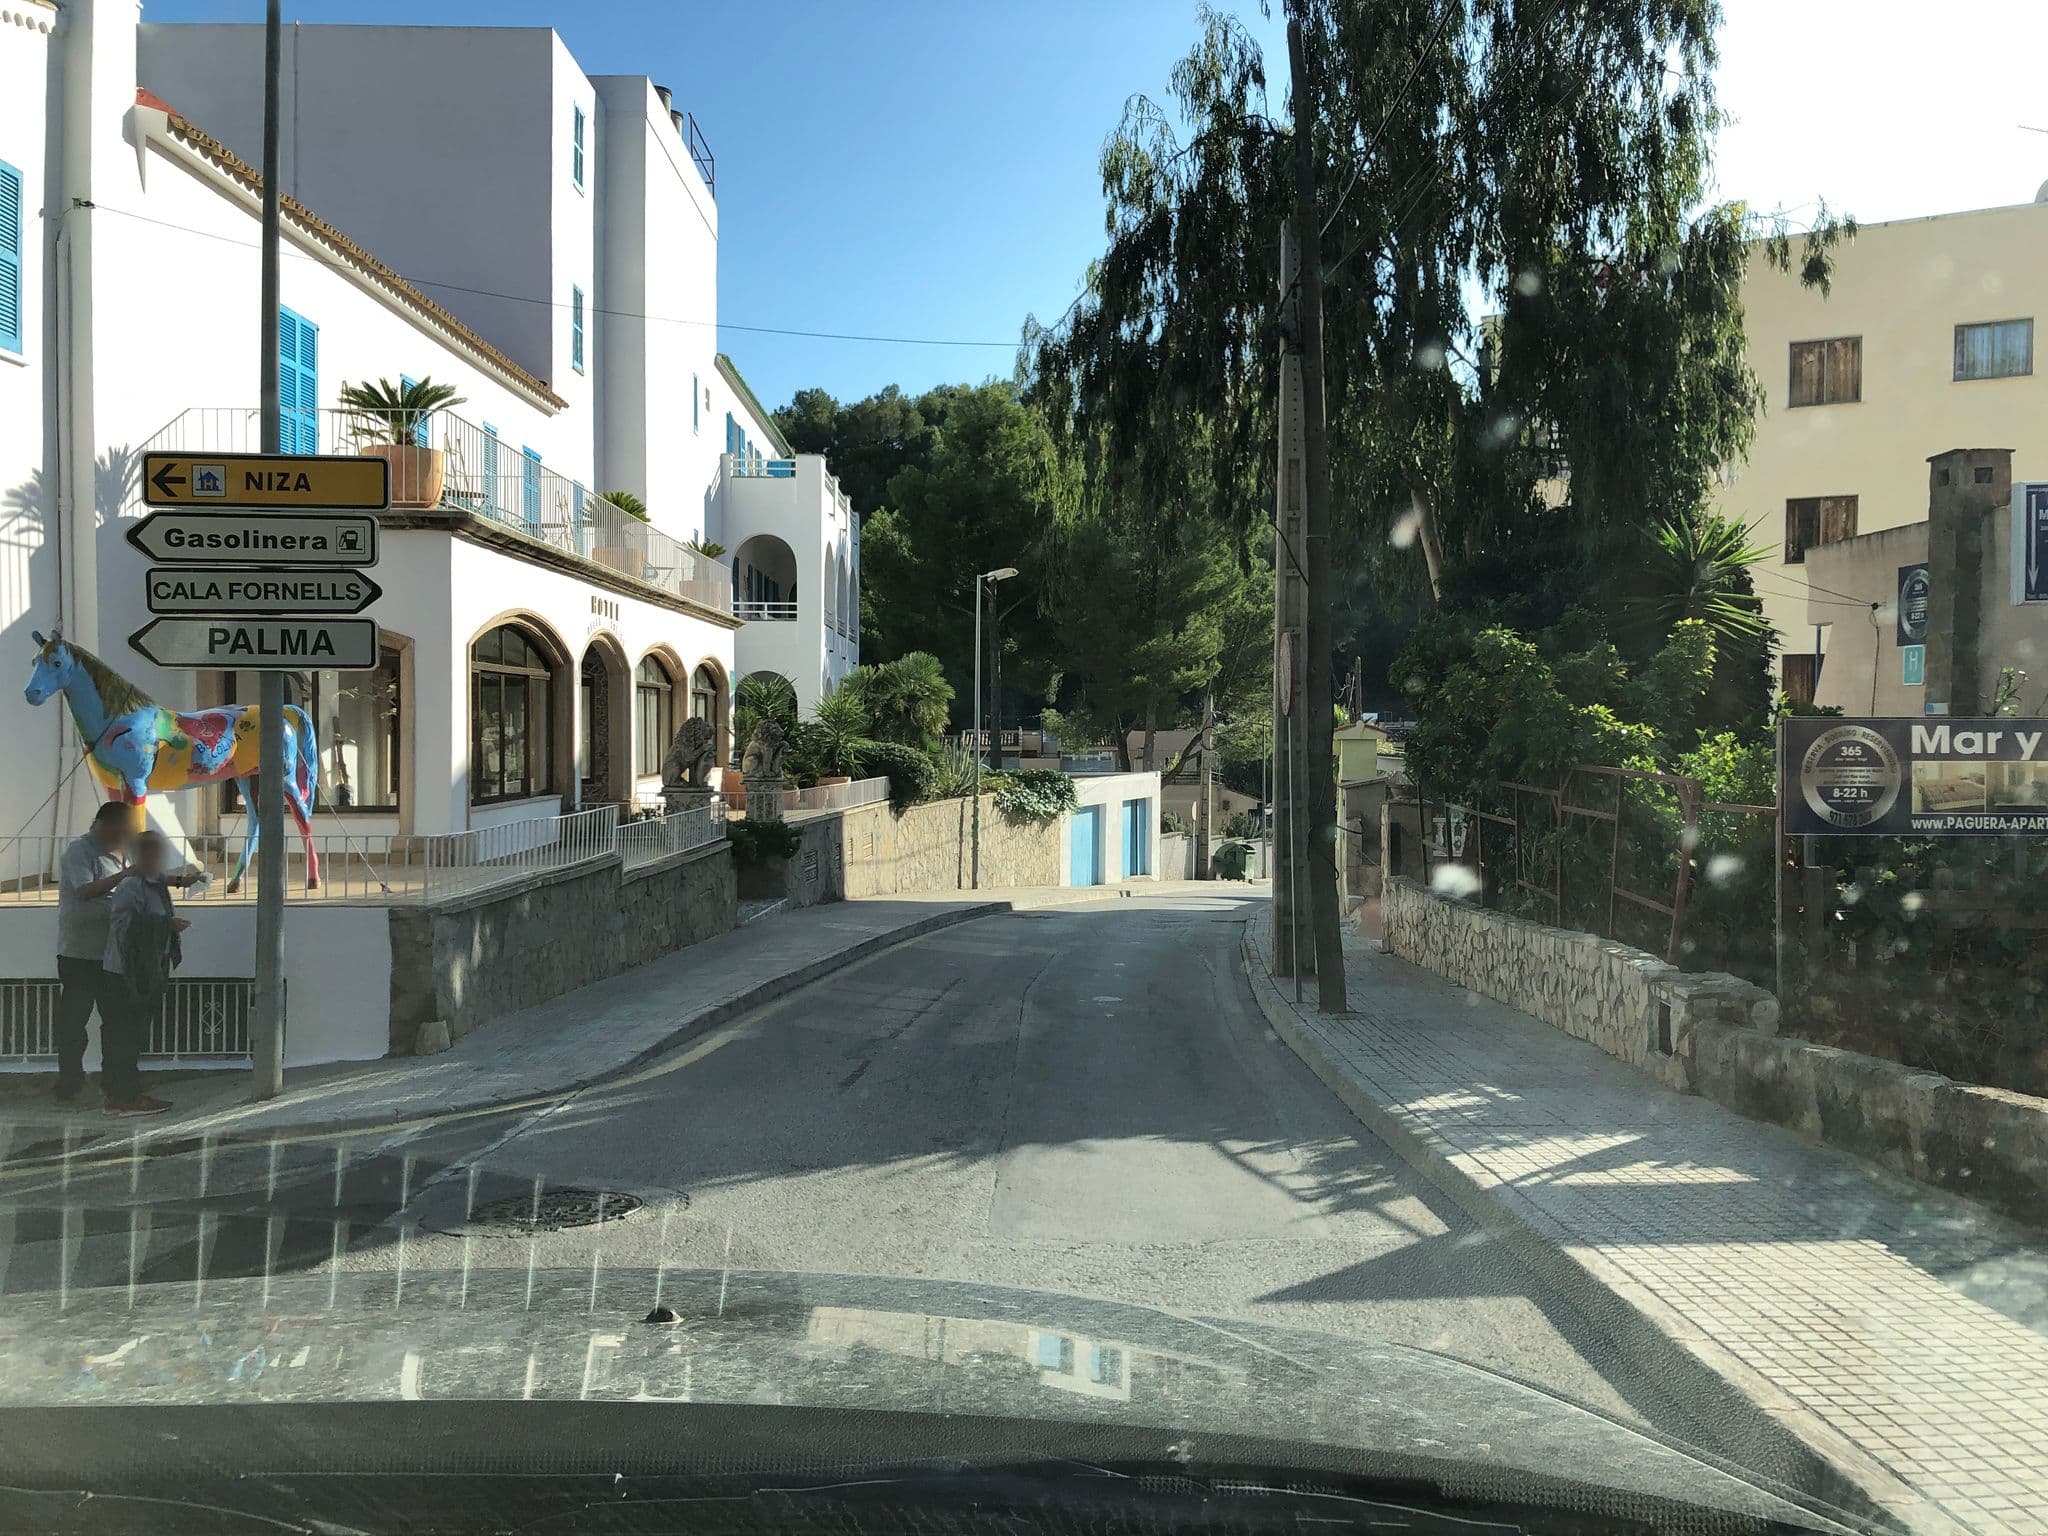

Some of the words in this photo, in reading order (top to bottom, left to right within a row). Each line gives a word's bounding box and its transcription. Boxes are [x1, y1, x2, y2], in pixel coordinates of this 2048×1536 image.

[245, 471, 312, 492] NIZA
[164, 528, 328, 550] Gasolinera
[153, 582, 223, 600] CALA
[228, 582, 361, 601] FORNELLS
[208, 627, 336, 656] PALMA
[1841, 746, 1862, 756] 365
[1911, 725, 2003, 755] Mar
[2014, 732, 2043, 760] y
[1833, 788, 1857, 798] 8-22
[1860, 788, 1868, 798] h
